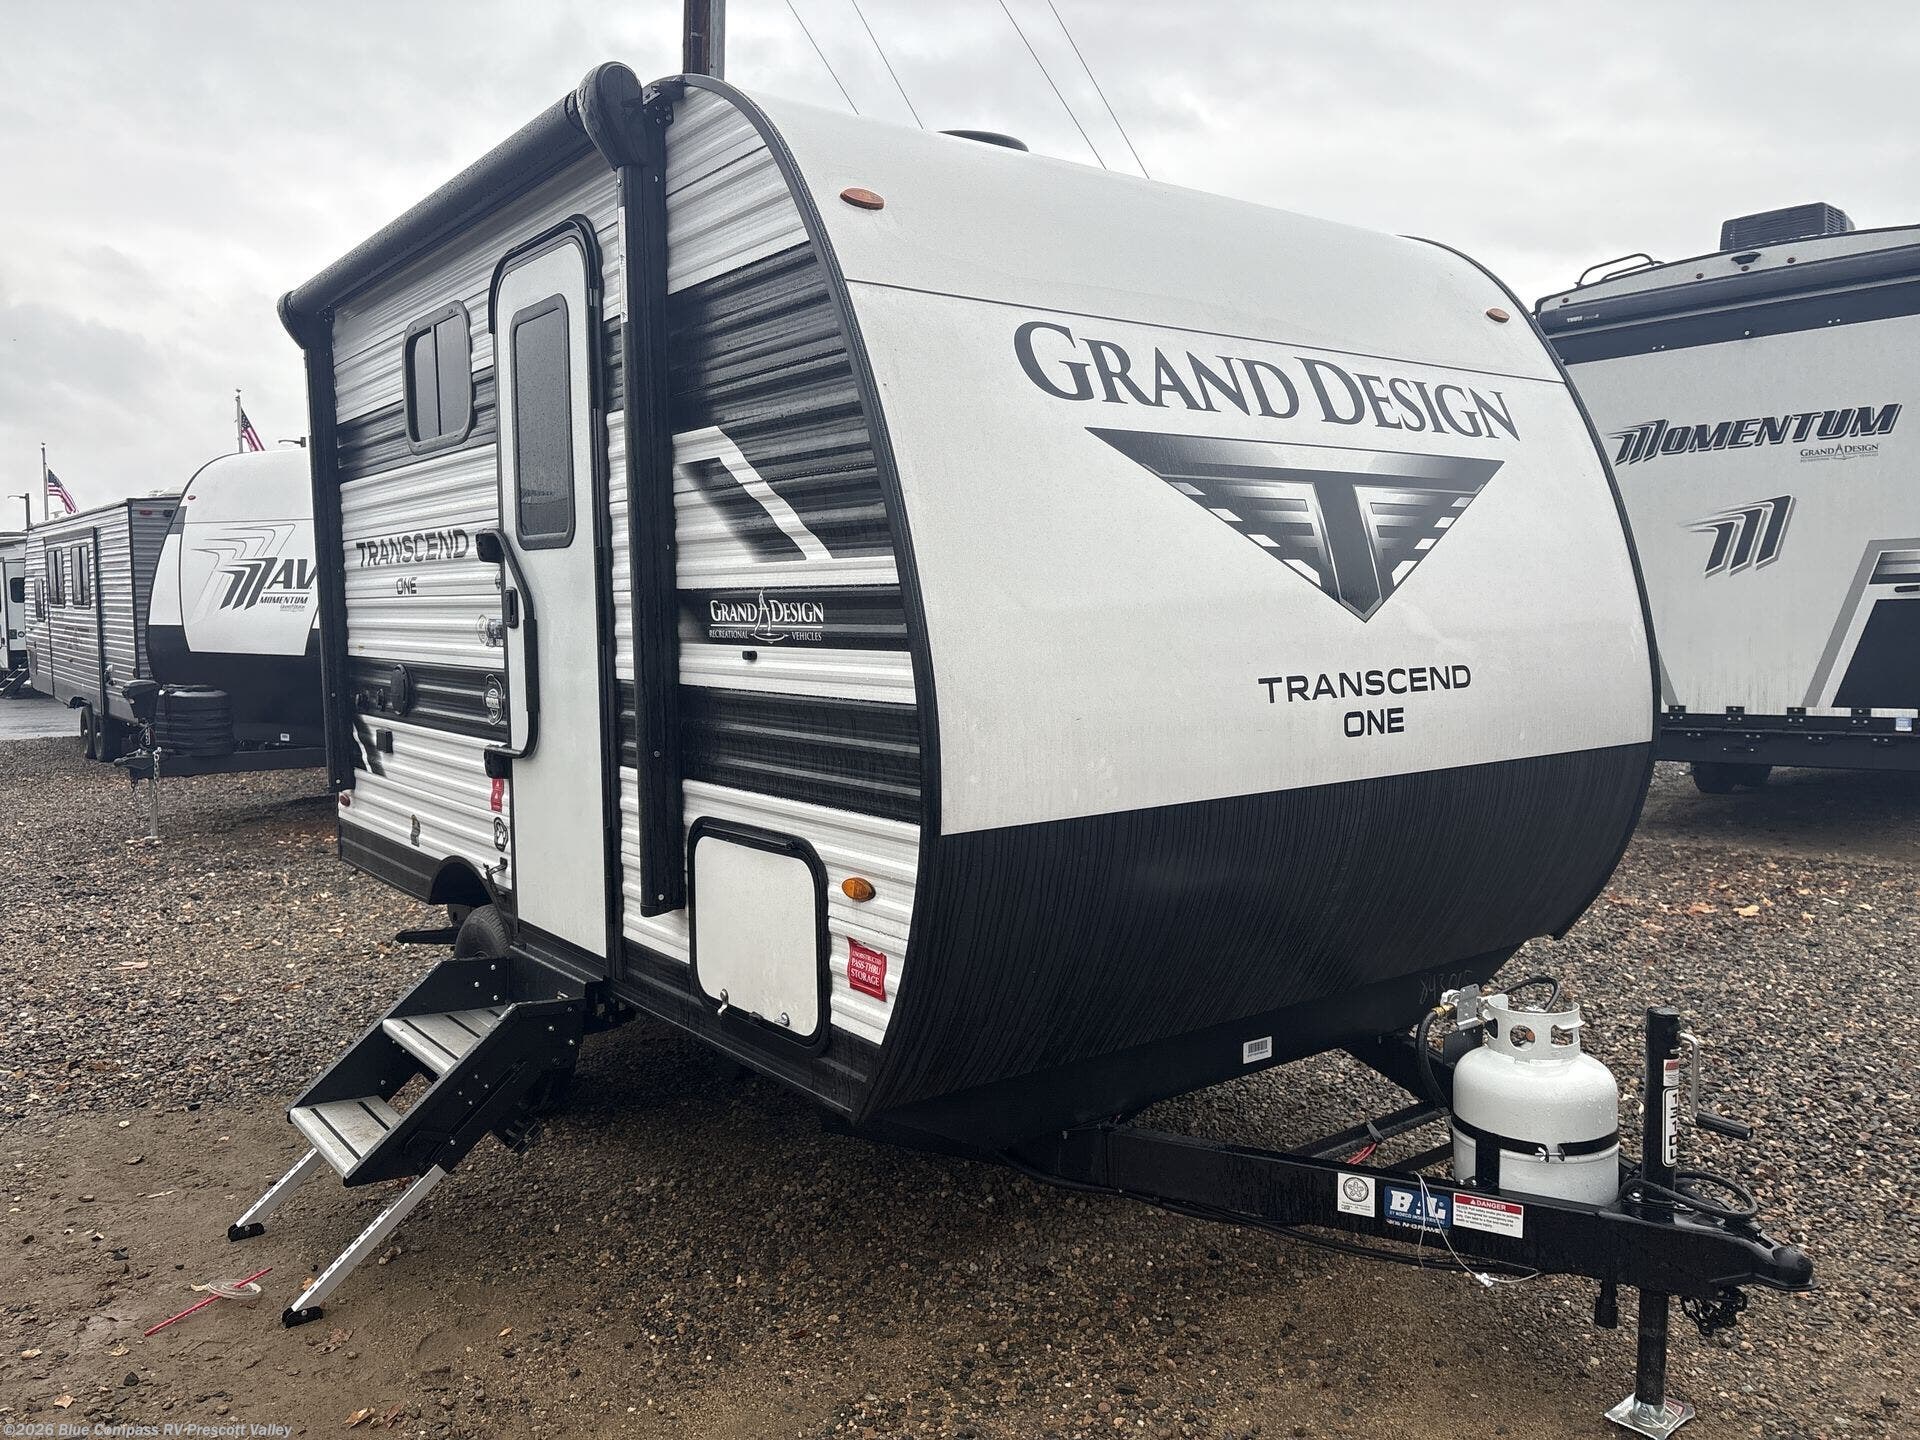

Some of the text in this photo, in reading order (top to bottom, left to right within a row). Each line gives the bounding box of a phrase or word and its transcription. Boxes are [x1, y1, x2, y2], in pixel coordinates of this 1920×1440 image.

[1014, 321, 1520, 441] GRAND DESIGN
[1607, 403, 1903, 466] MOMENTUM
[1800, 443, 1879, 457] GRAND DESIGN
[356, 529, 469, 567] TRANSCEND
[396, 577, 417, 595] ONE
[260, 597, 308, 605] MOMENTUM
[710, 600, 824, 623] GRAND DESIGN
[709, 629, 822, 642] RECREATIONAL VEHICLES
[1258, 665, 1472, 704] TRANSCEND
[1344, 707, 1405, 738] ONE
[851, 957, 881, 976] PASS-THRU
[850, 968, 880, 987] STORAGE
[1476, 1200, 1507, 1211] DANGER
